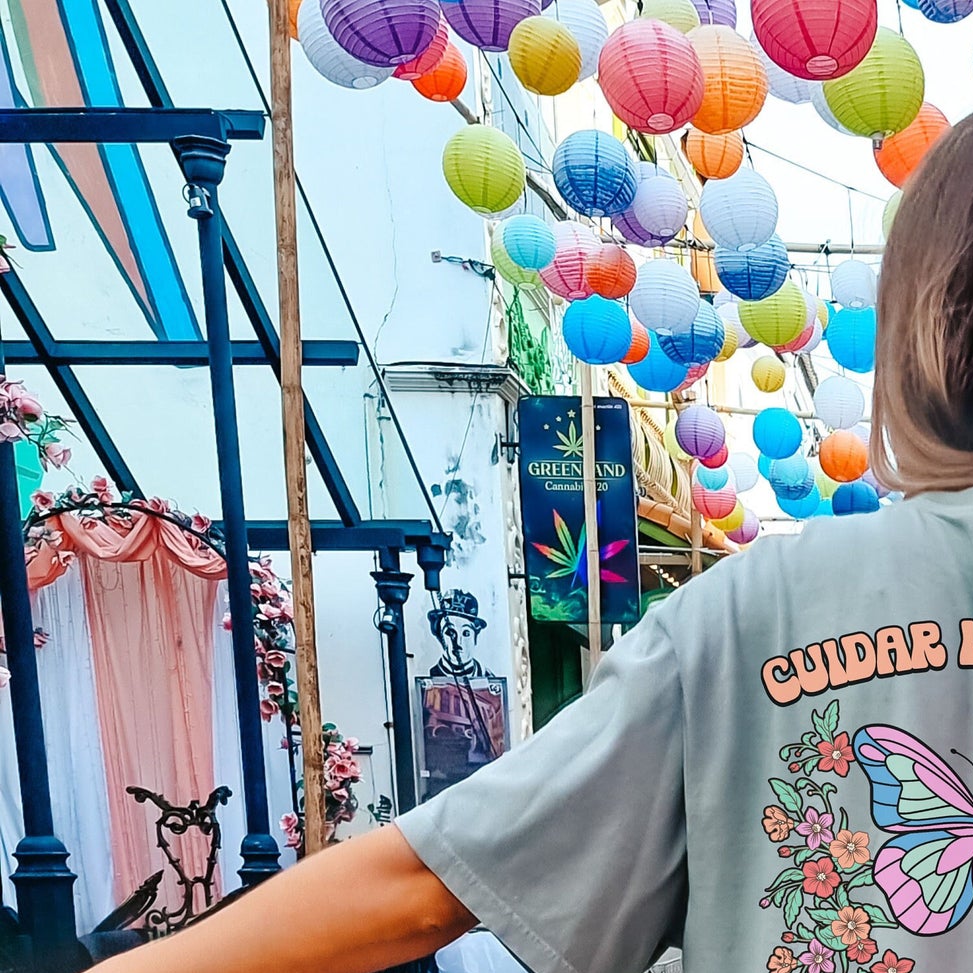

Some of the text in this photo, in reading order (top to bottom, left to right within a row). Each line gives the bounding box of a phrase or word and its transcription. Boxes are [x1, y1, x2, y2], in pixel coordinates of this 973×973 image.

[528, 462, 626, 477] GREENAND
[545, 481, 588, 492] Cannabi
[761, 620, 948, 707] CUIDAR
